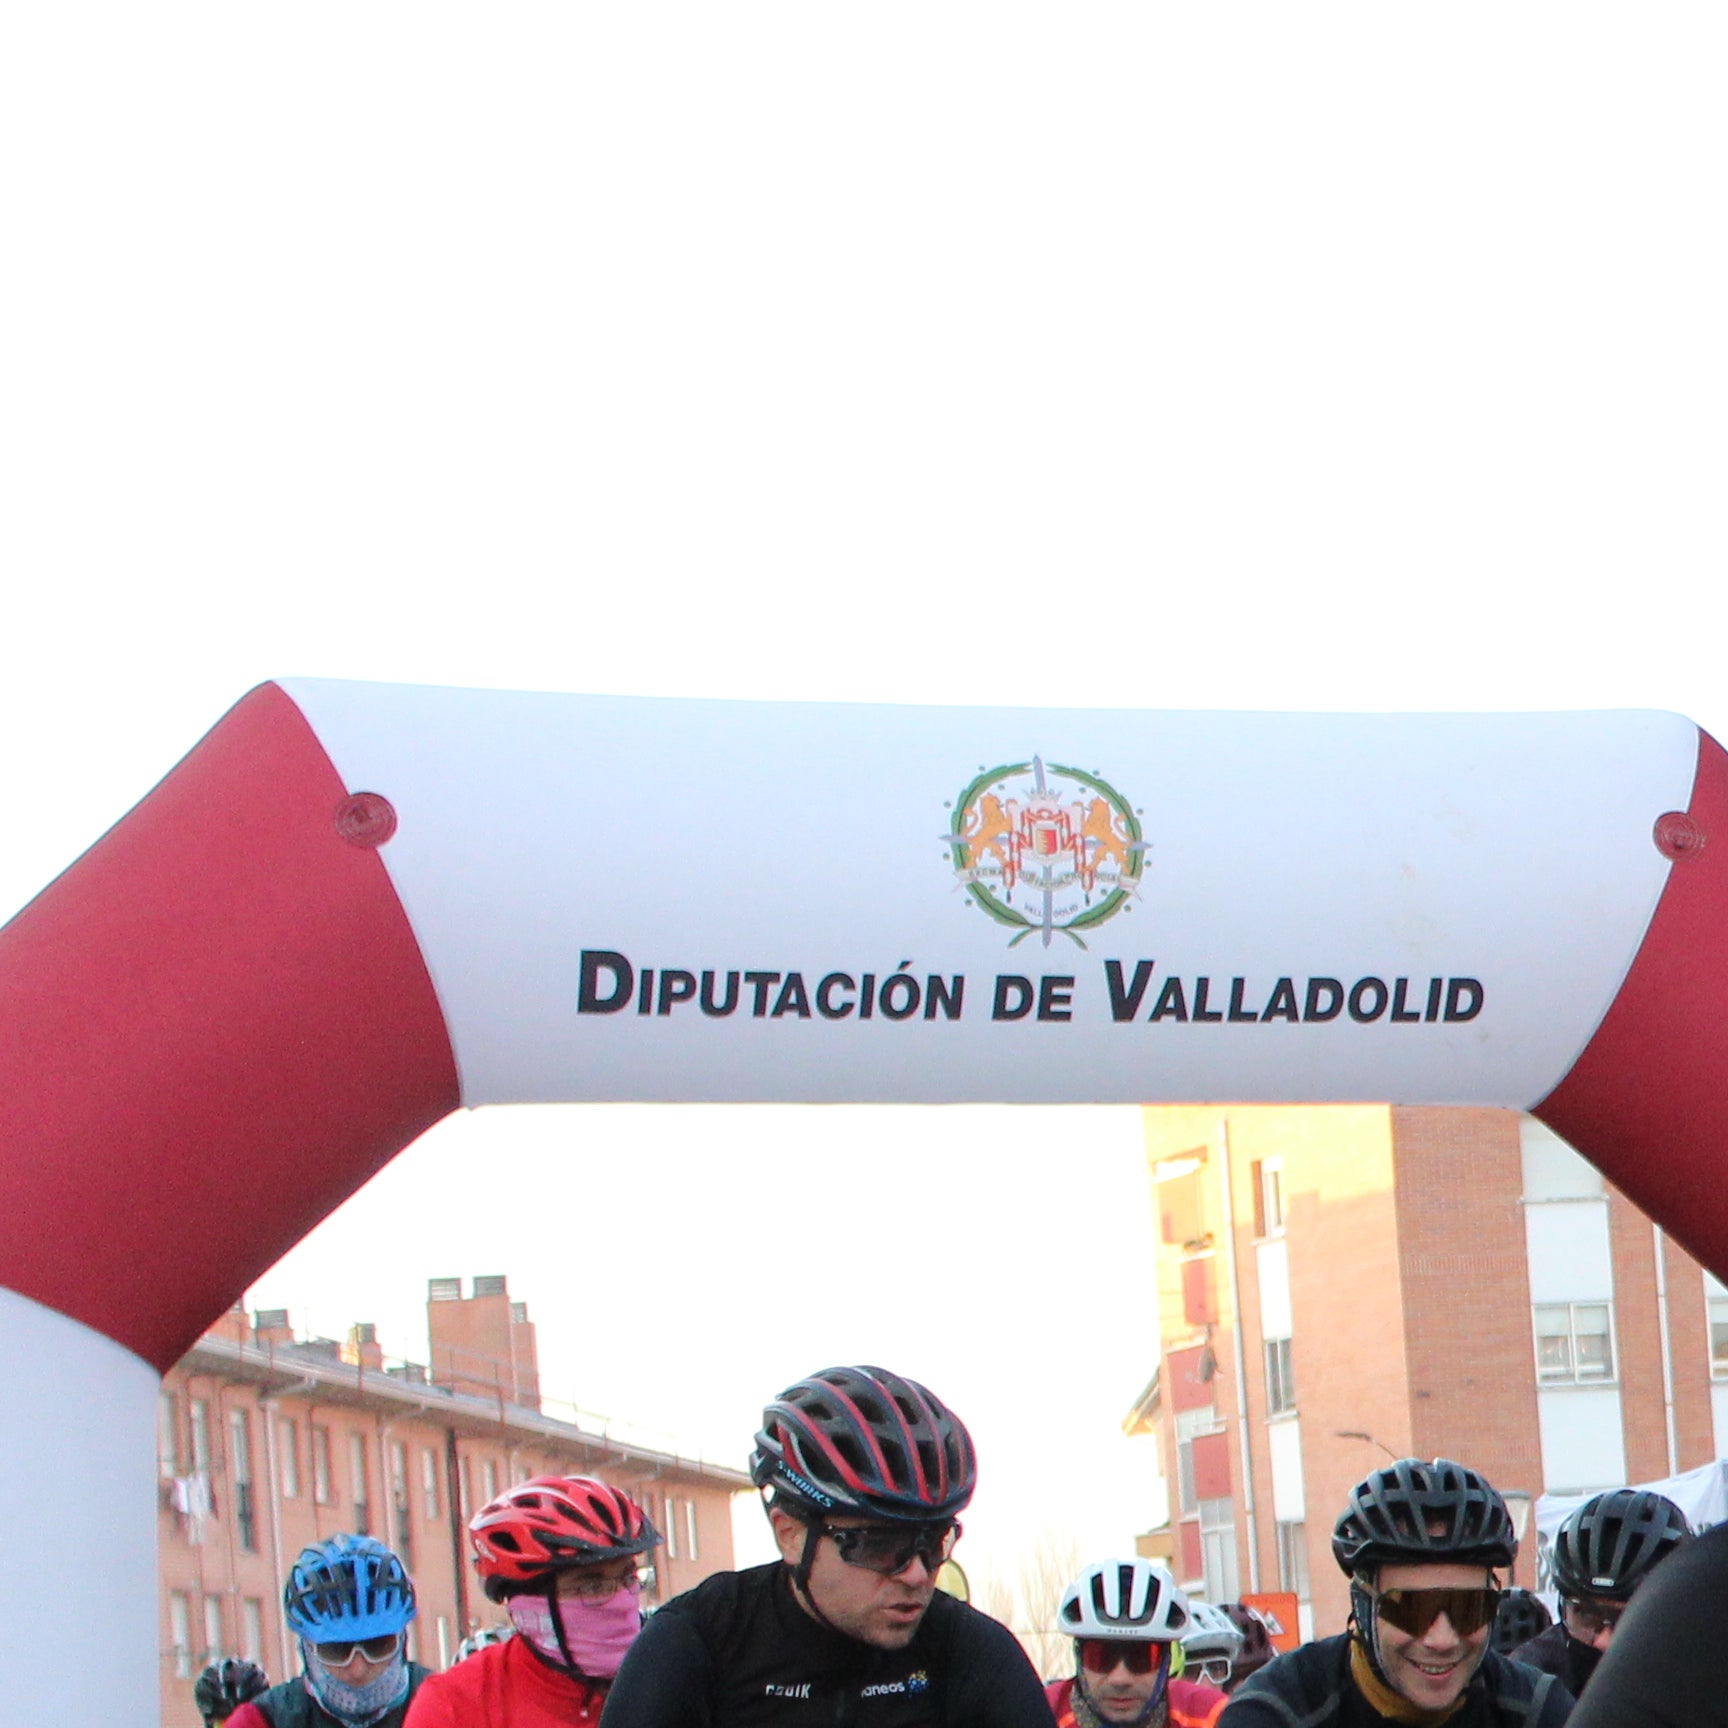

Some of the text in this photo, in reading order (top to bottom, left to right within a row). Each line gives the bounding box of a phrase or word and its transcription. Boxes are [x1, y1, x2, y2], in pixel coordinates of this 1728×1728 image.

[576, 948, 1484, 1024] DIPUTACIÓN DE VALLADOLID
